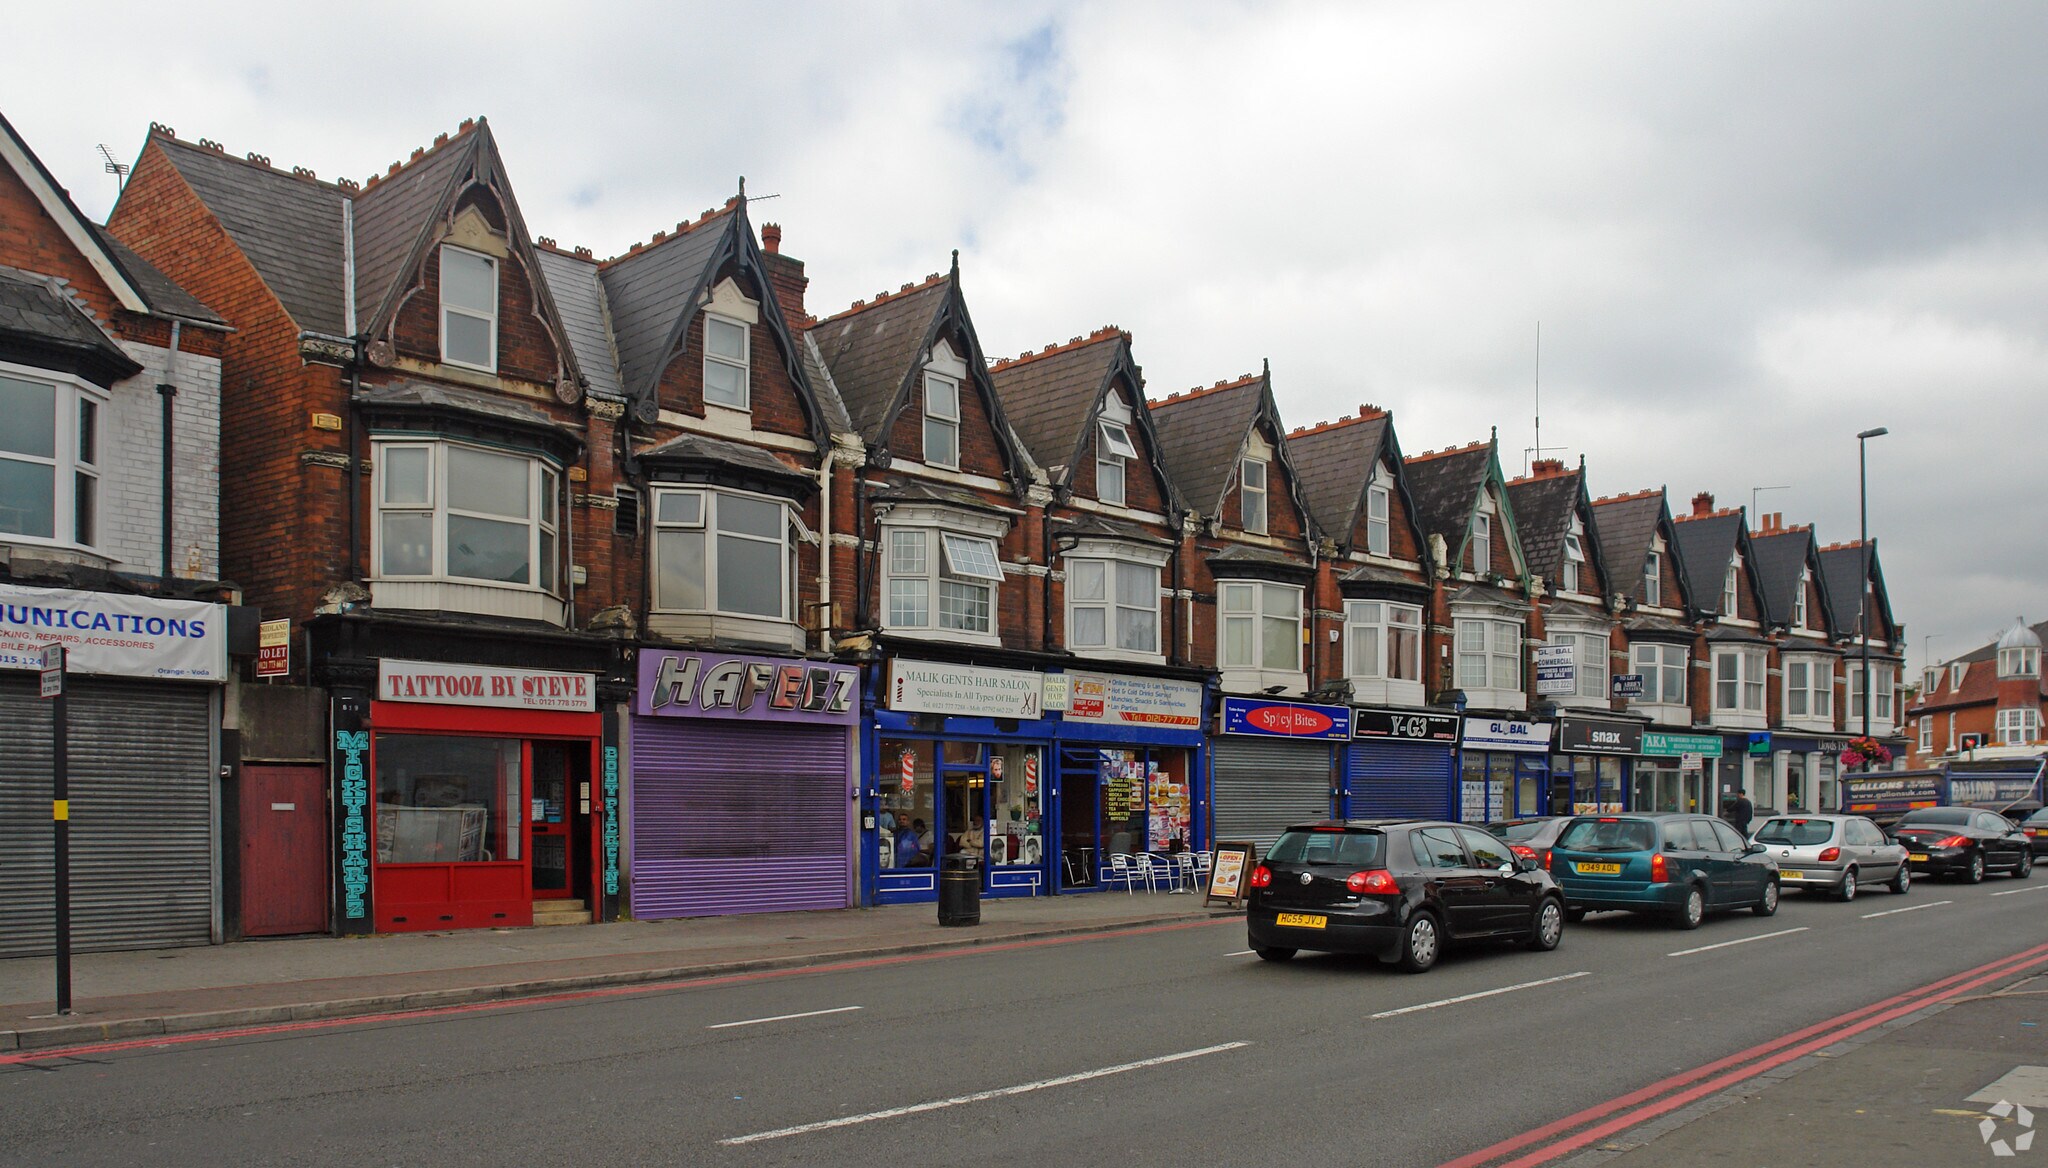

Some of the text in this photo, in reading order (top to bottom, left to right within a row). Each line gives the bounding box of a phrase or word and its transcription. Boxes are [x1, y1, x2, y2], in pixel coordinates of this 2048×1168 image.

[0, 603, 205, 638] UNICATIONS
[85, 637, 155, 650] ACCESSORIES
[260, 648, 286, 658] TO LET
[158, 668, 184, 676] Orange
[388, 675, 587, 697] TATTOOZ BY STEVE
[650, 656, 857, 714] HAFEEZ
[906, 671, 939, 683] MALIK
[942, 674, 973, 686] GENTS
[975, 677, 998, 688] HAIR
[1000, 679, 1030, 690] SALON
[1046, 676, 1067, 684] MALIK
[1128, 681, 1146, 689] Gaming
[1046, 684, 1066, 692] GENTS
[917, 688, 953, 697] Specialists
[955, 690, 962, 698] In
[963, 692, 974, 700] All
[976, 692, 995, 703] Types
[1005, 694, 1019, 703] Hair
[1264, 710, 1317, 728] Spicy Bites
[1646, 736, 1666, 747] AKA
[1818, 739, 1836, 752] Lloyds
[1850, 781, 1904, 791] GALLONS
[1952, 780, 1996, 802] GALLONS
[1581, 863, 1599, 871] Y349
[1280, 914, 1324, 925] HG55 JVJ
